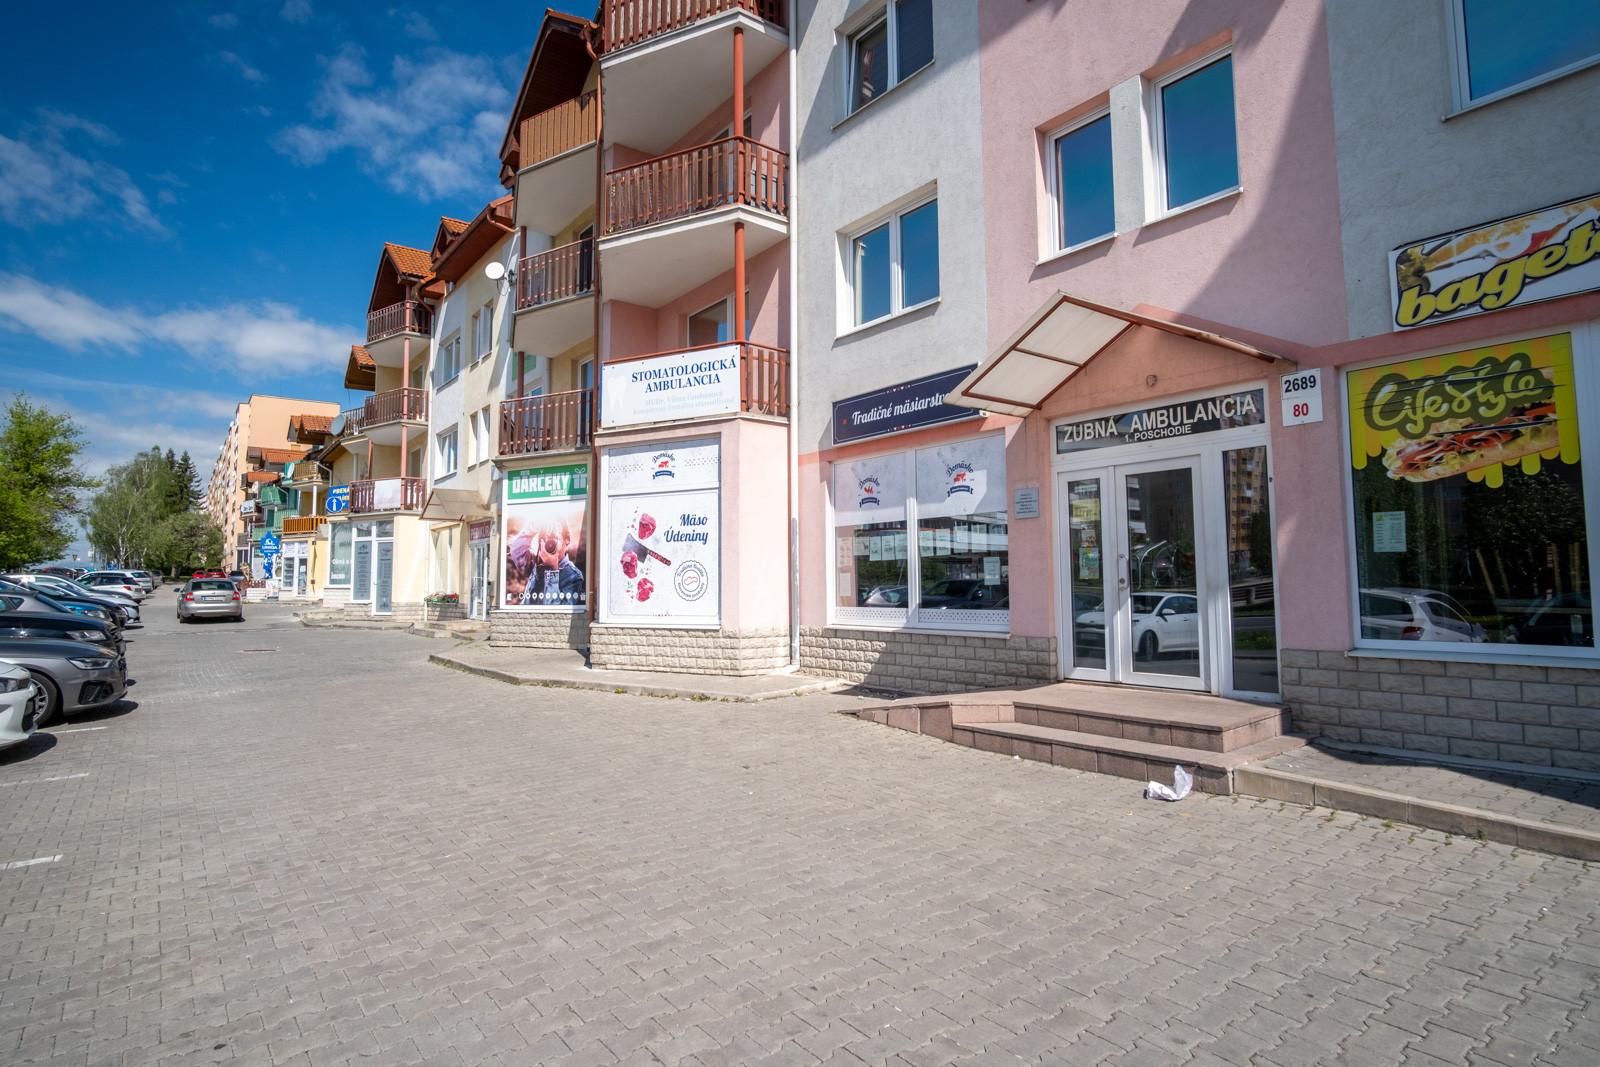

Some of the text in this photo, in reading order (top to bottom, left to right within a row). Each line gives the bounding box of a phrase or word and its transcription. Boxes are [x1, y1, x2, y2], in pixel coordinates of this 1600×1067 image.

[1396, 218, 1600, 327] baget
[631, 355, 737, 383] STOMATOLOGICKÁ
[644, 373, 721, 393] AMBULANCIA
[1284, 374, 1317, 394] 2689
[851, 402, 892, 426] Tradičné
[1063, 394, 1257, 443] ZUBNÁ AMBULANCIA
[1292, 402, 1310, 418] 80
[1124, 424, 1193, 443] 1. POSCHODIE
[679, 513, 708, 527] Mäso
[663, 526, 709, 546] Údeniny
